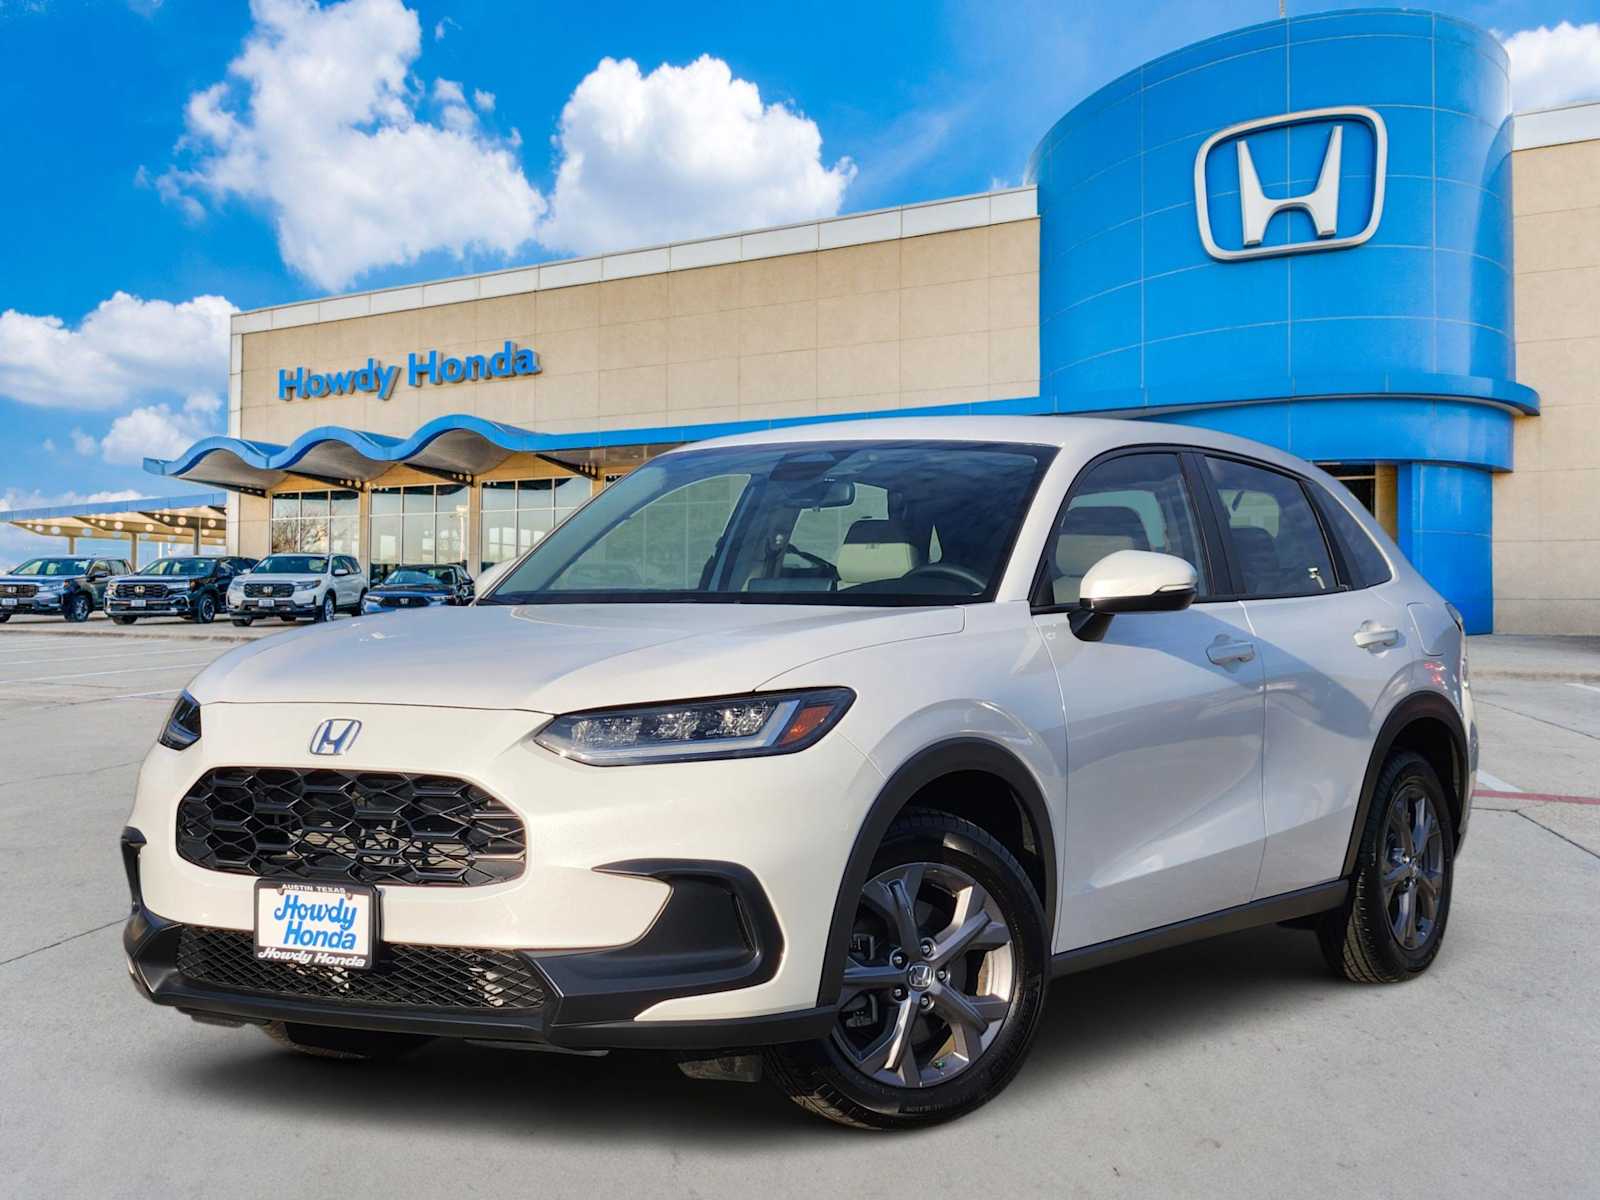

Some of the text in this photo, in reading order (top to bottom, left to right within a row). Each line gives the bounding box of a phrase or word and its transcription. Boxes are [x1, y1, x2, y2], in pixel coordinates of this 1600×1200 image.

[278, 340, 542, 401] Howdy Honda
[281, 883, 346, 894] AUSTIN TEXAS
[274, 894, 357, 930] Howdy
[283, 920, 357, 950] Honda
[258, 947, 366, 967] Howdy Honda
